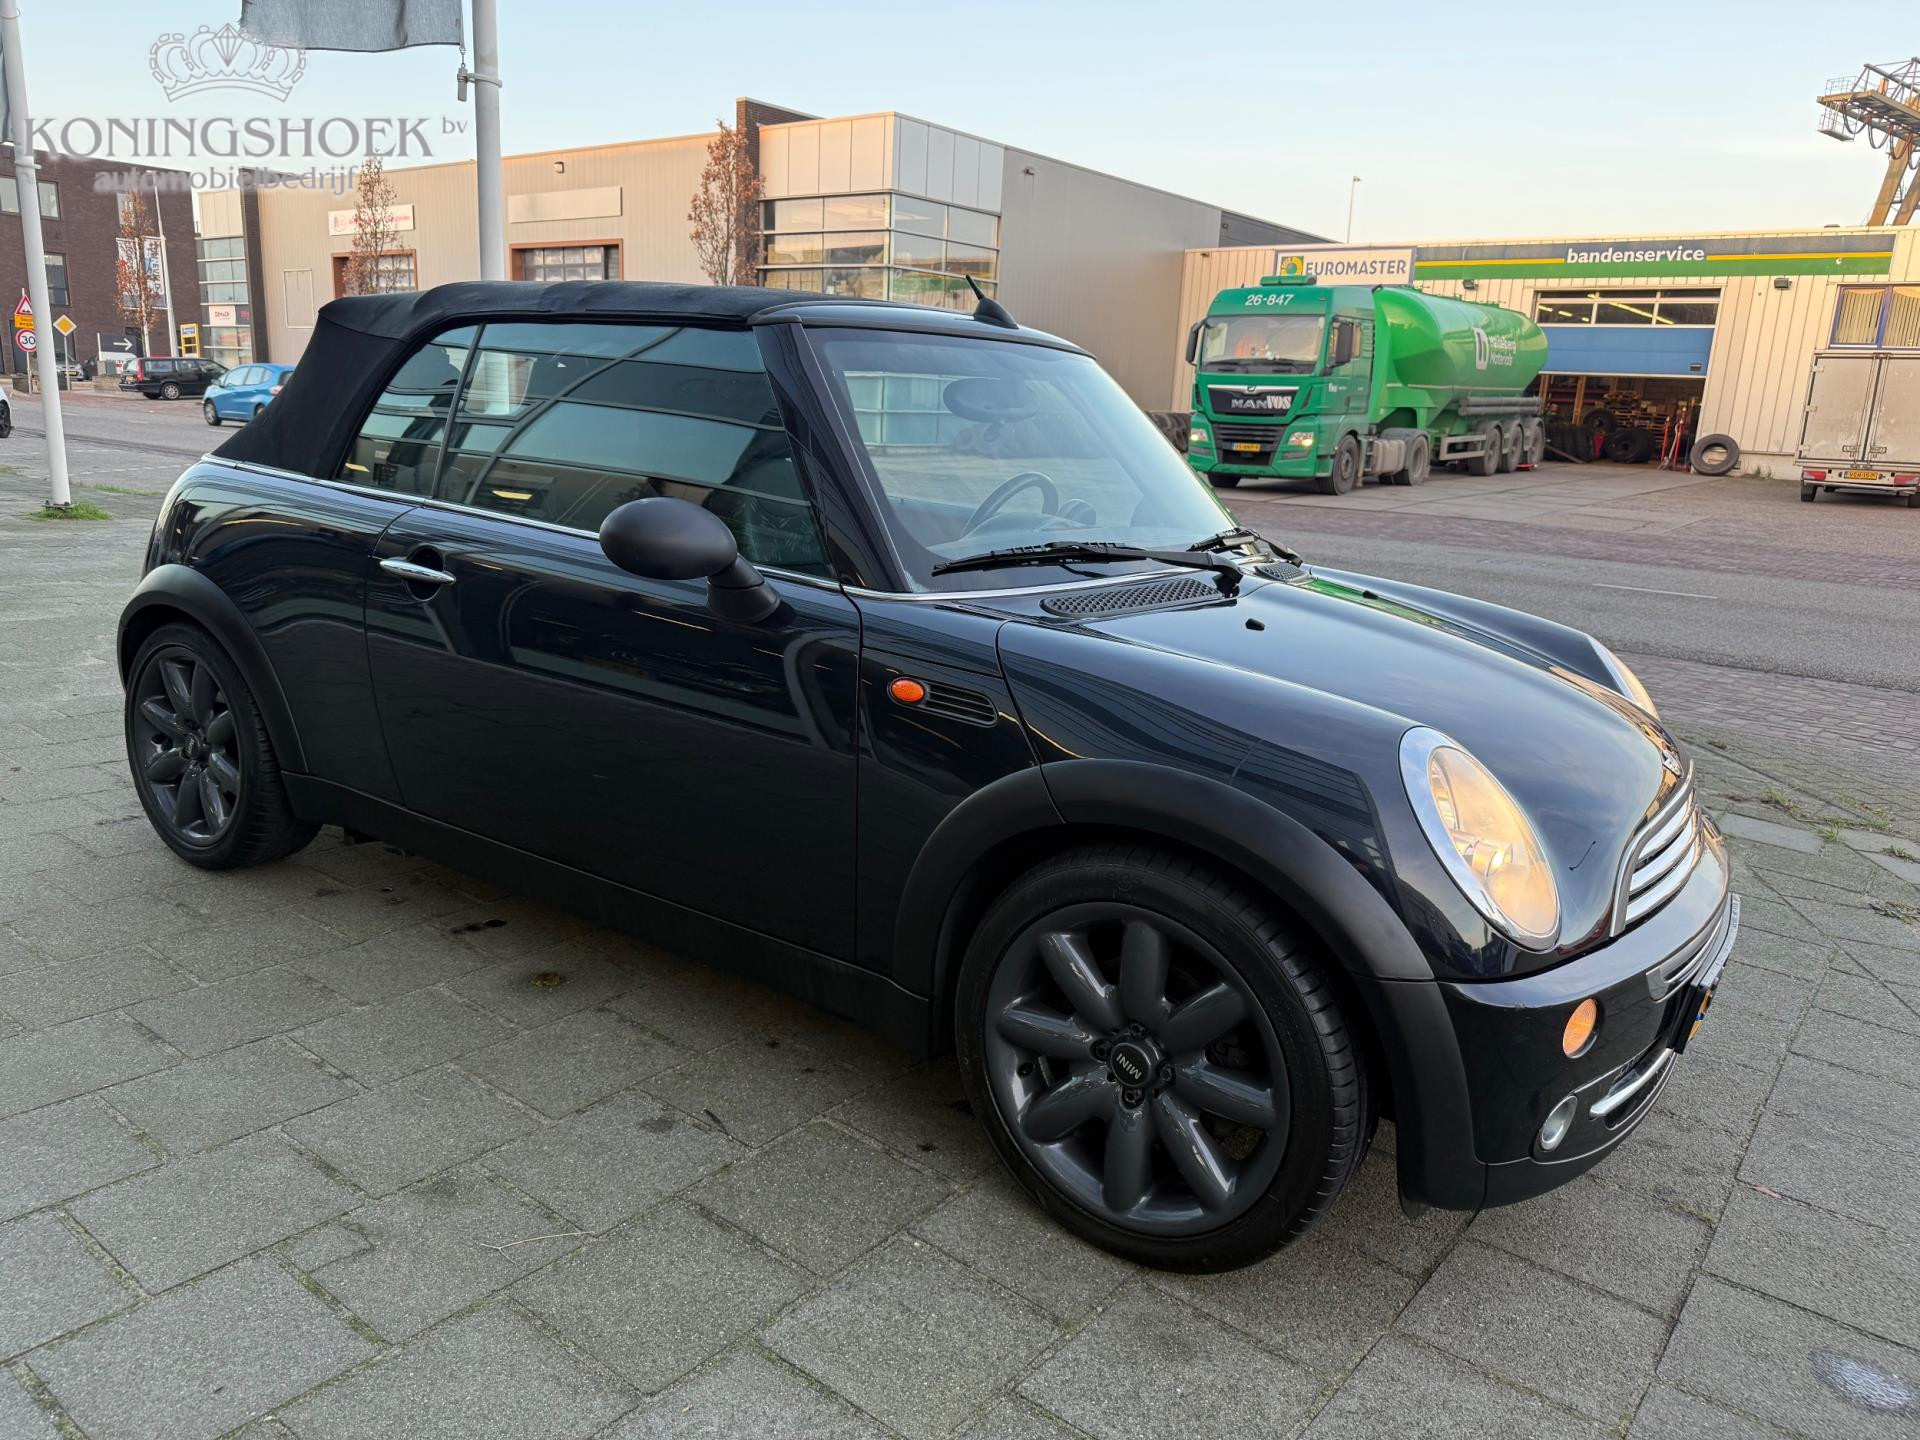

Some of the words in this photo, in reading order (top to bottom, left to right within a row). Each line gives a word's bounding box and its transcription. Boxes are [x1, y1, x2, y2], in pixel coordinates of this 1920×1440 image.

[1566, 245, 1705, 265] bandenservice
[1305, 259, 1407, 276] EUROMASTER
[1245, 294, 1294, 306] 26-847
[1231, 399, 1267, 409] MAN
[1115, 1053, 1142, 1080] MINI
